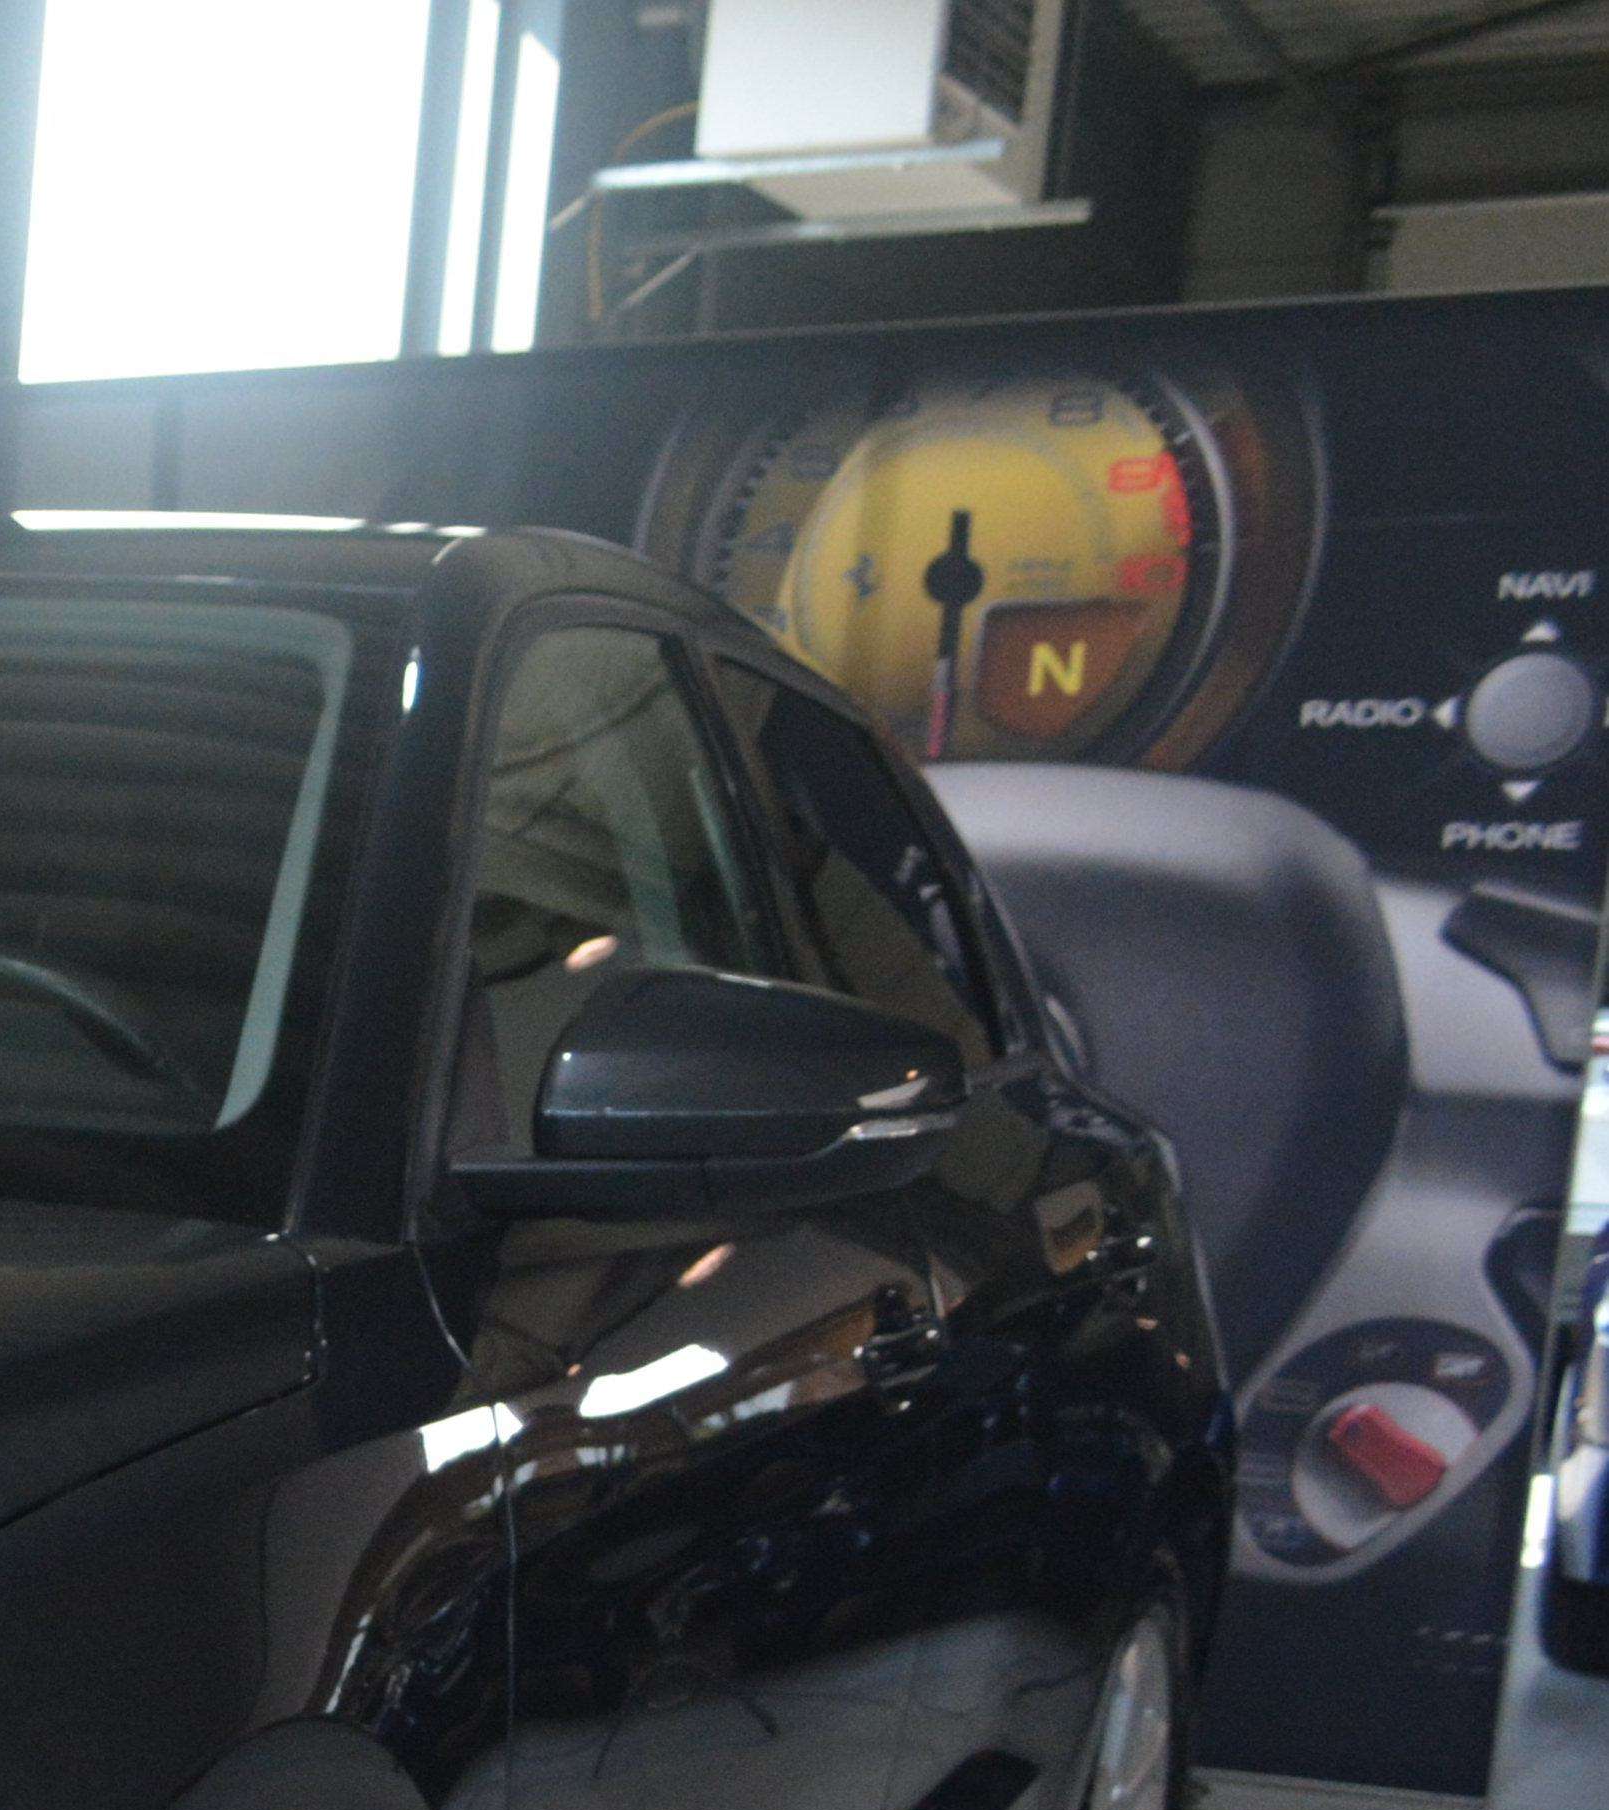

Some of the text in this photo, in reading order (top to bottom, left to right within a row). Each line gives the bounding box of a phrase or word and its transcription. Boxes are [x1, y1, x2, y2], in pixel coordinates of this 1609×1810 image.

[1497, 569, 1595, 601] NAVI
[1028, 642, 1087, 697] N
[1298, 698, 1424, 729] RADIO
[1441, 822, 1583, 850] PHONE
